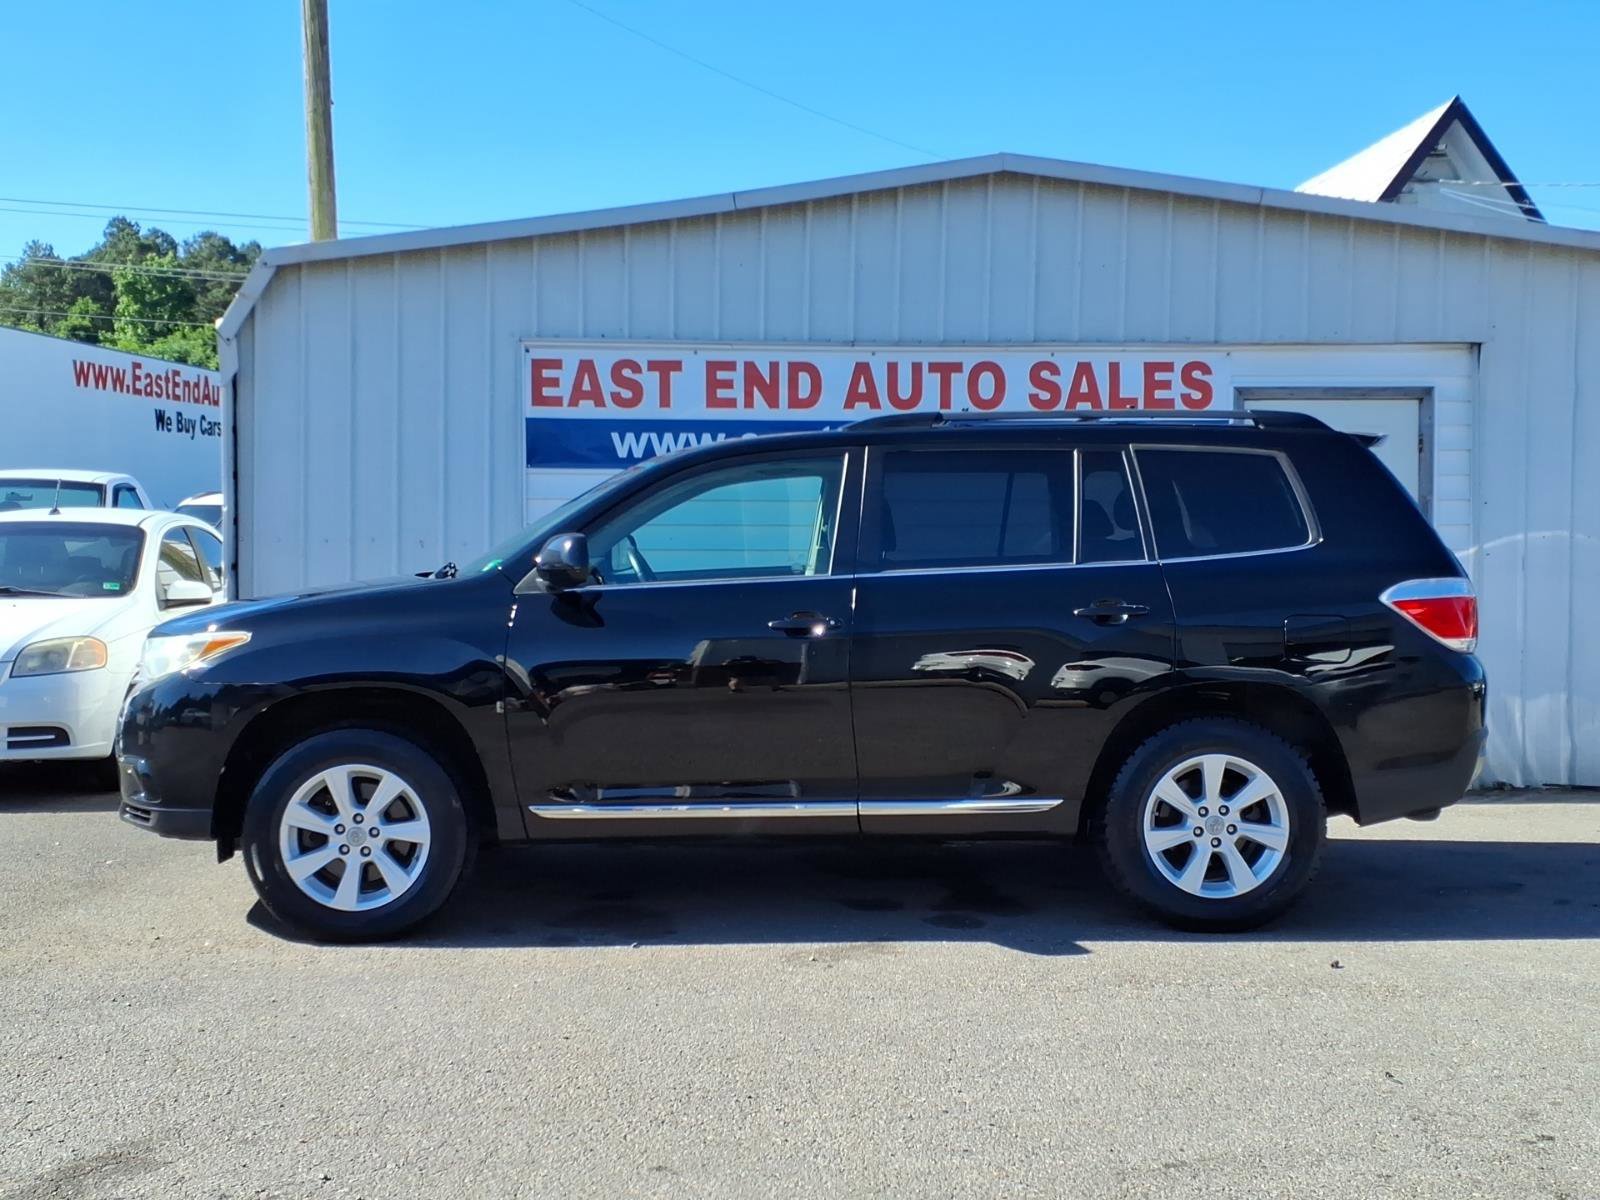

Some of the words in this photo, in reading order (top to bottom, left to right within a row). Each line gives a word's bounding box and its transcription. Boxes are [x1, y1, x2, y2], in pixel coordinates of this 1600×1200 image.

[530, 358, 682, 409] EAST
[705, 360, 823, 410] END
[843, 360, 1007, 411] AUTO
[1028, 361, 1214, 411] SALES
[155, 408, 173, 433] We
[176, 411, 197, 440] Buy
[200, 414, 221, 438] Cars
